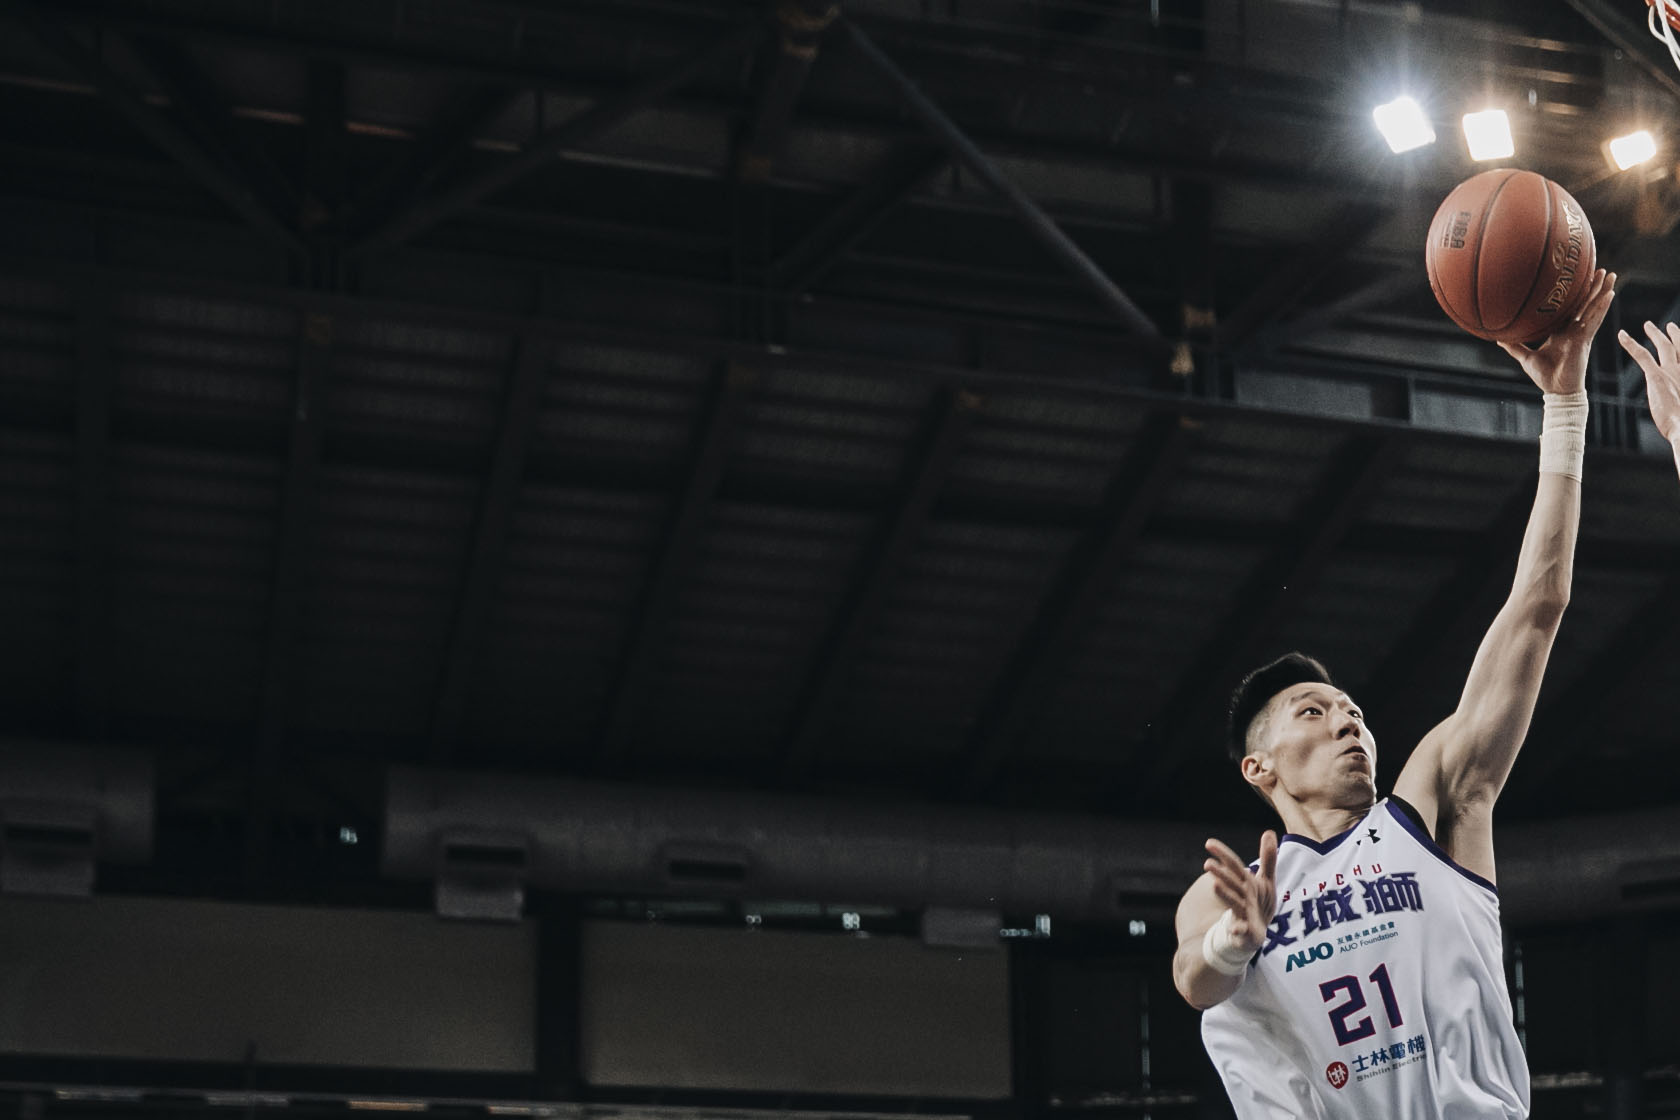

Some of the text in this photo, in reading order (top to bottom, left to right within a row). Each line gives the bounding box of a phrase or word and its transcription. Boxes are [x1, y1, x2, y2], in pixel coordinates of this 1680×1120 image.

[1285, 942, 1334, 972] AUO
[1339, 930, 1399, 954] AUO Foundation
[1318, 962, 1405, 1047] 21
[1351, 1033, 1427, 1073] 士林電機
